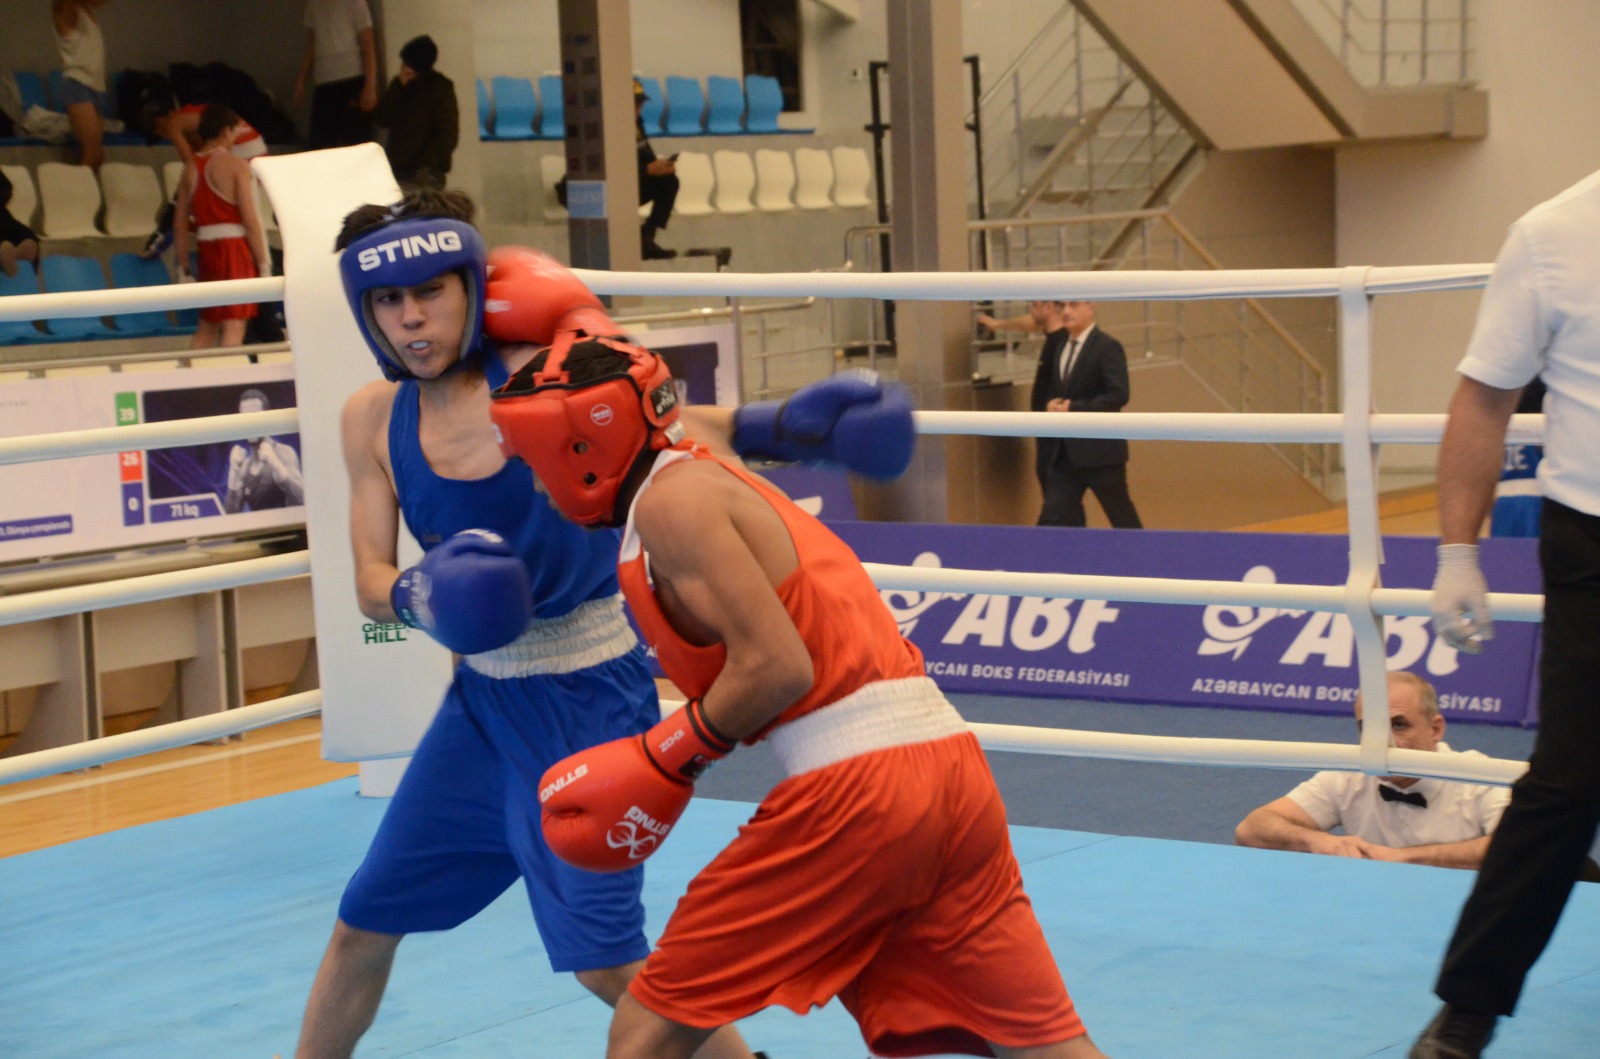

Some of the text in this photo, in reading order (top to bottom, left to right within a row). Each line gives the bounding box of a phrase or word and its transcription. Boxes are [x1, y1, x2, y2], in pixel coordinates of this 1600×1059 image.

[358, 230, 463, 271] STING
[365, 630, 407, 644] HILL
[971, 663, 1014, 680] BOKS
[1017, 667, 1130, 687] FEDERASİYASI
[1191, 678, 1311, 700] AZƏRBAYCAN
[539, 763, 589, 803] STING
[624, 804, 671, 836] STING
